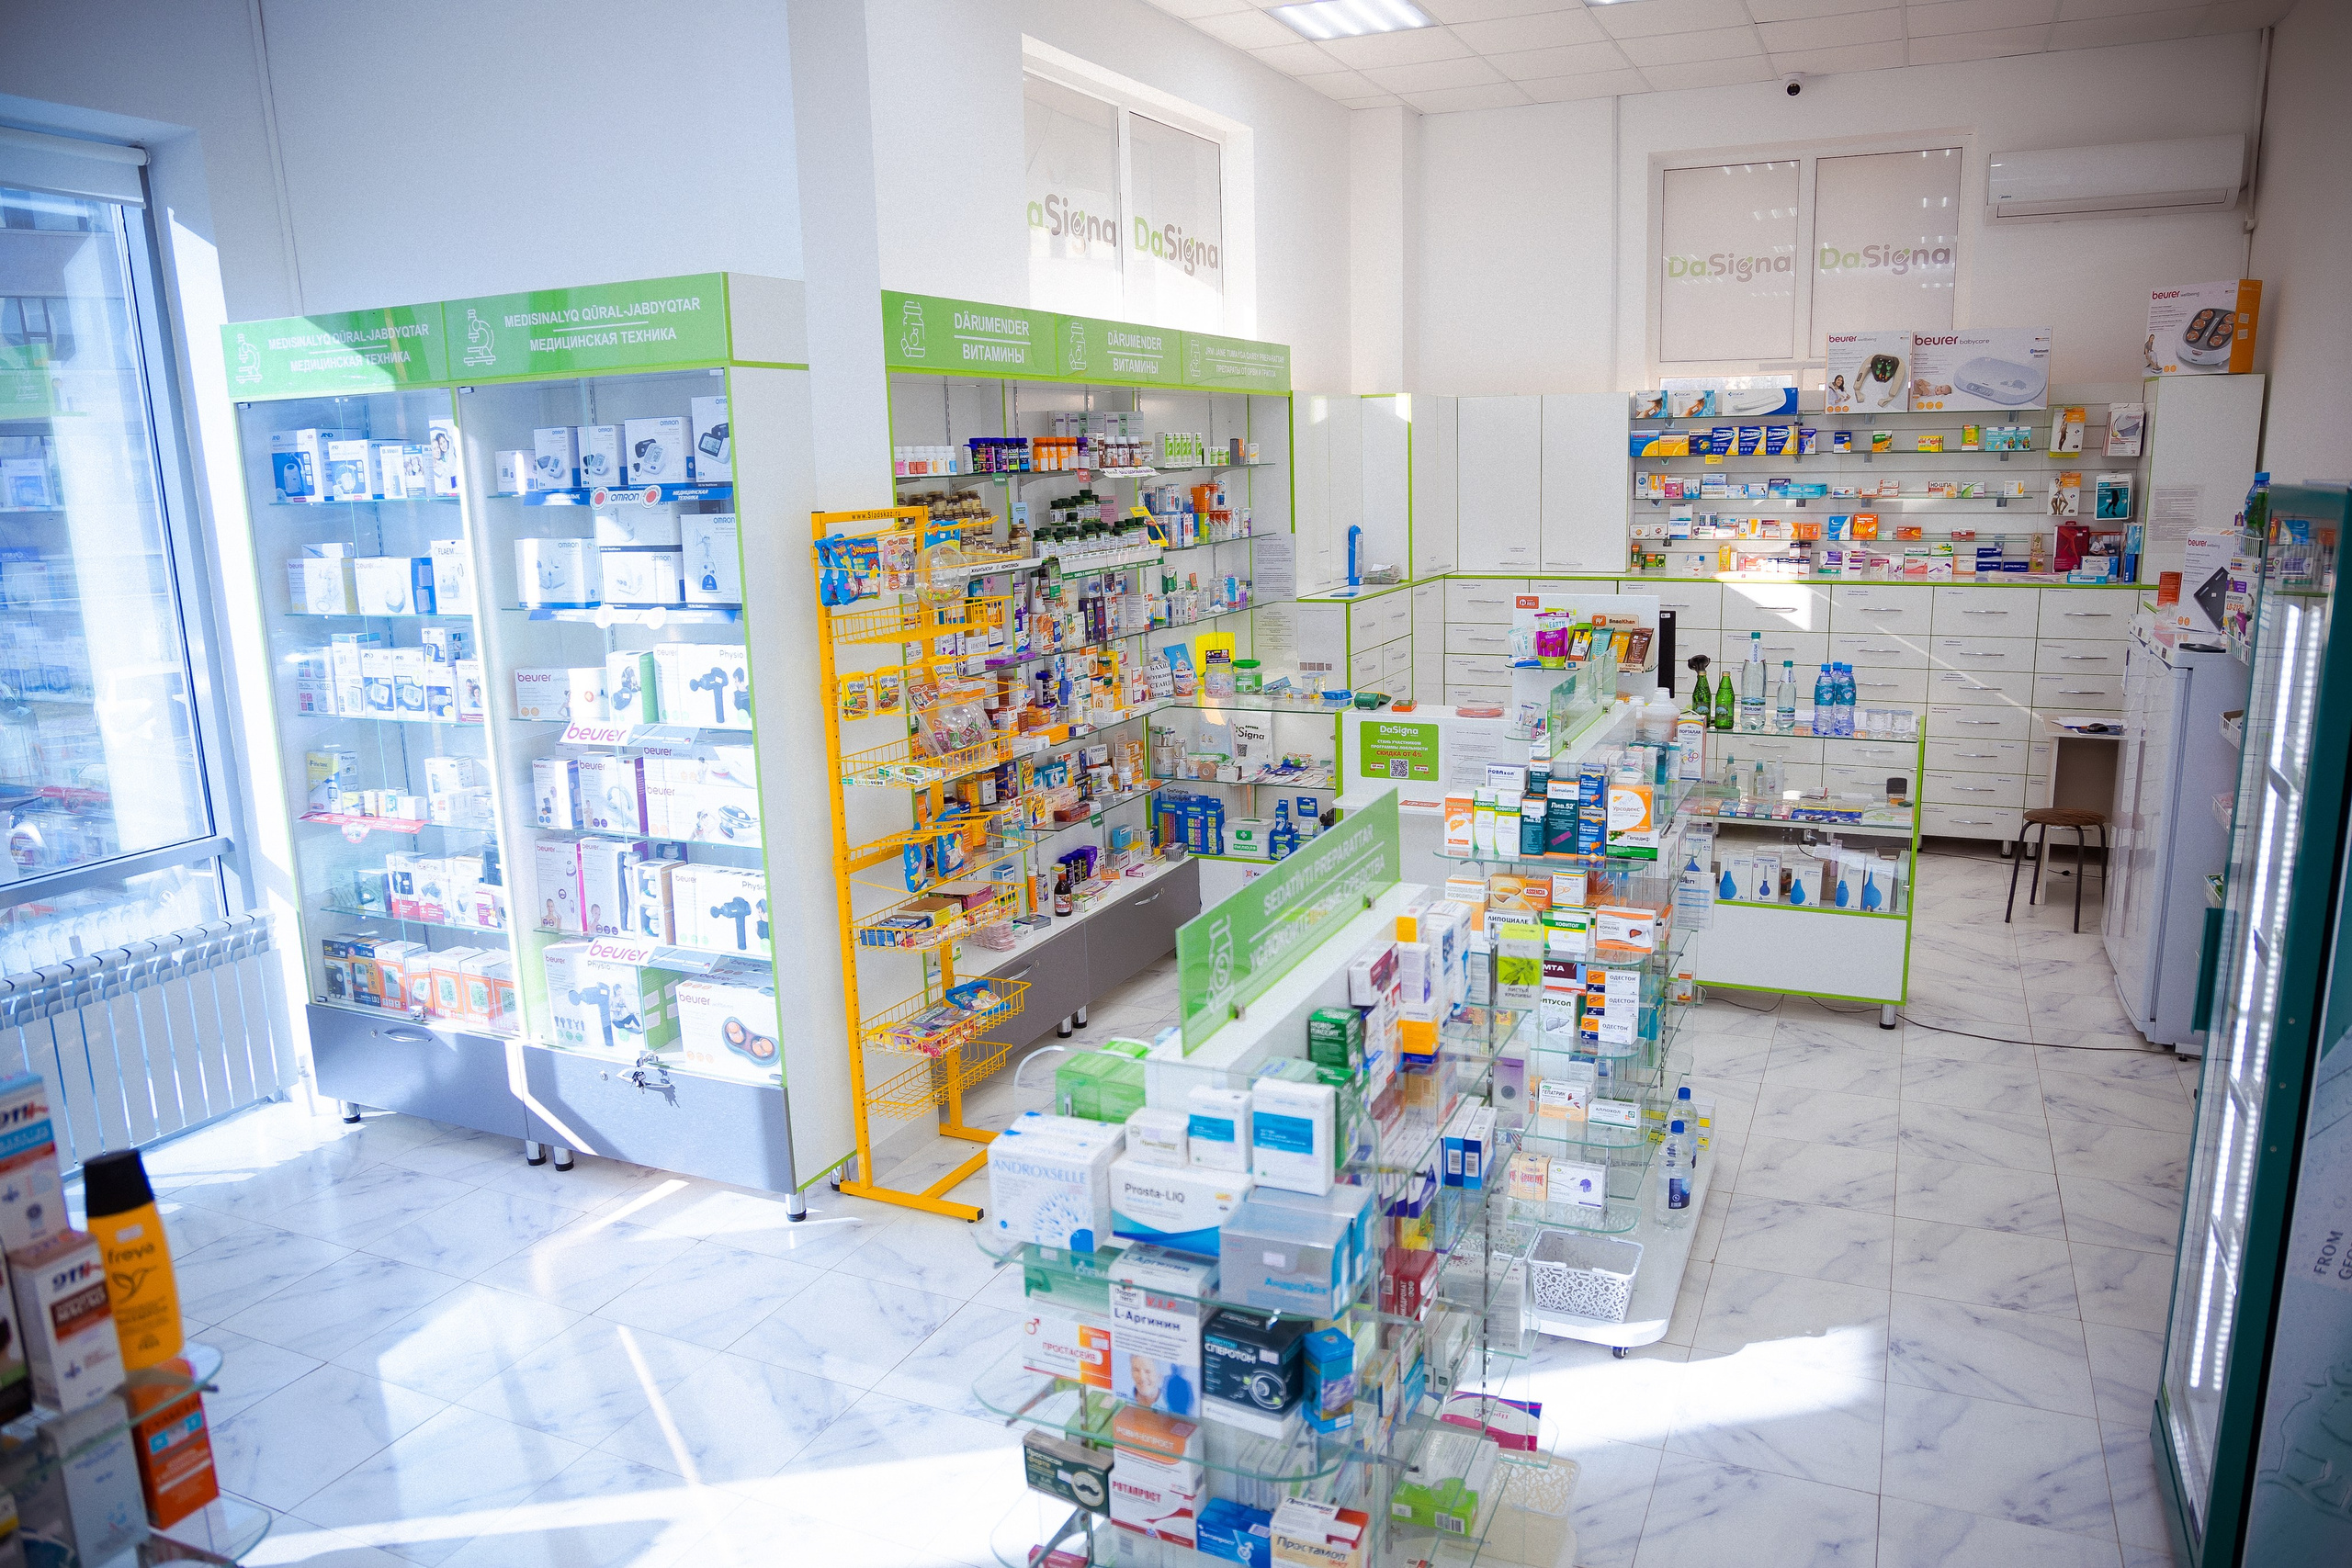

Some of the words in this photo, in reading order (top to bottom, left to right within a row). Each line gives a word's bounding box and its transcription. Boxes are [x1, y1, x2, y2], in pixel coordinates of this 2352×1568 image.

[2152, 290, 2180, 300] beurer
[504, 310, 580, 327] MEDISINALYQ
[954, 310, 1030, 336] DÄRUMENDER
[268, 333, 332, 350] MEDISINALYQ
[530, 332, 618, 352] МЕДИЦИНСКАЯ
[620, 327, 676, 344] ТЕХНИКА
[1107, 331, 1162, 351] DÄRUMENDER
[1828, 334, 1857, 344] beurer
[1915, 335, 1958, 346] beurer
[290, 355, 363, 373] МЕДИЦИНСКАЯ
[364, 350, 411, 366] ТЕХНИКА
[962, 344, 1024, 364] ВИТАМИНЫ
[1114, 358, 1159, 375] ВИТАМИНЫ
[610, 492, 639, 503] OMRON
[2188, 537, 2207, 547] beurer
[719, 649, 744, 660] Physio
[517, 671, 551, 683] beurer
[567, 723, 627, 742] beurer
[644, 746, 672, 757] beurer
[580, 759, 605, 771] beurer
[647, 784, 675, 795] beurer
[1551, 801, 1575, 810] Лив.52
[590, 940, 648, 962] beurer
[679, 991, 710, 1007] beurer
[1601, 1022, 1629, 1031] ОДЕСТОН
[992, 1159, 1086, 1184] ANDROXSELLE
[2313, 1230, 2344, 1276] FROM
[1114, 1307, 1182, 1332] L-Аргинин
[1204, 1343, 1257, 1364] СПЕРОТОН
[1286, 1497, 1334, 1512] Простамол
[1277, 1536, 1346, 1561] Простамол
